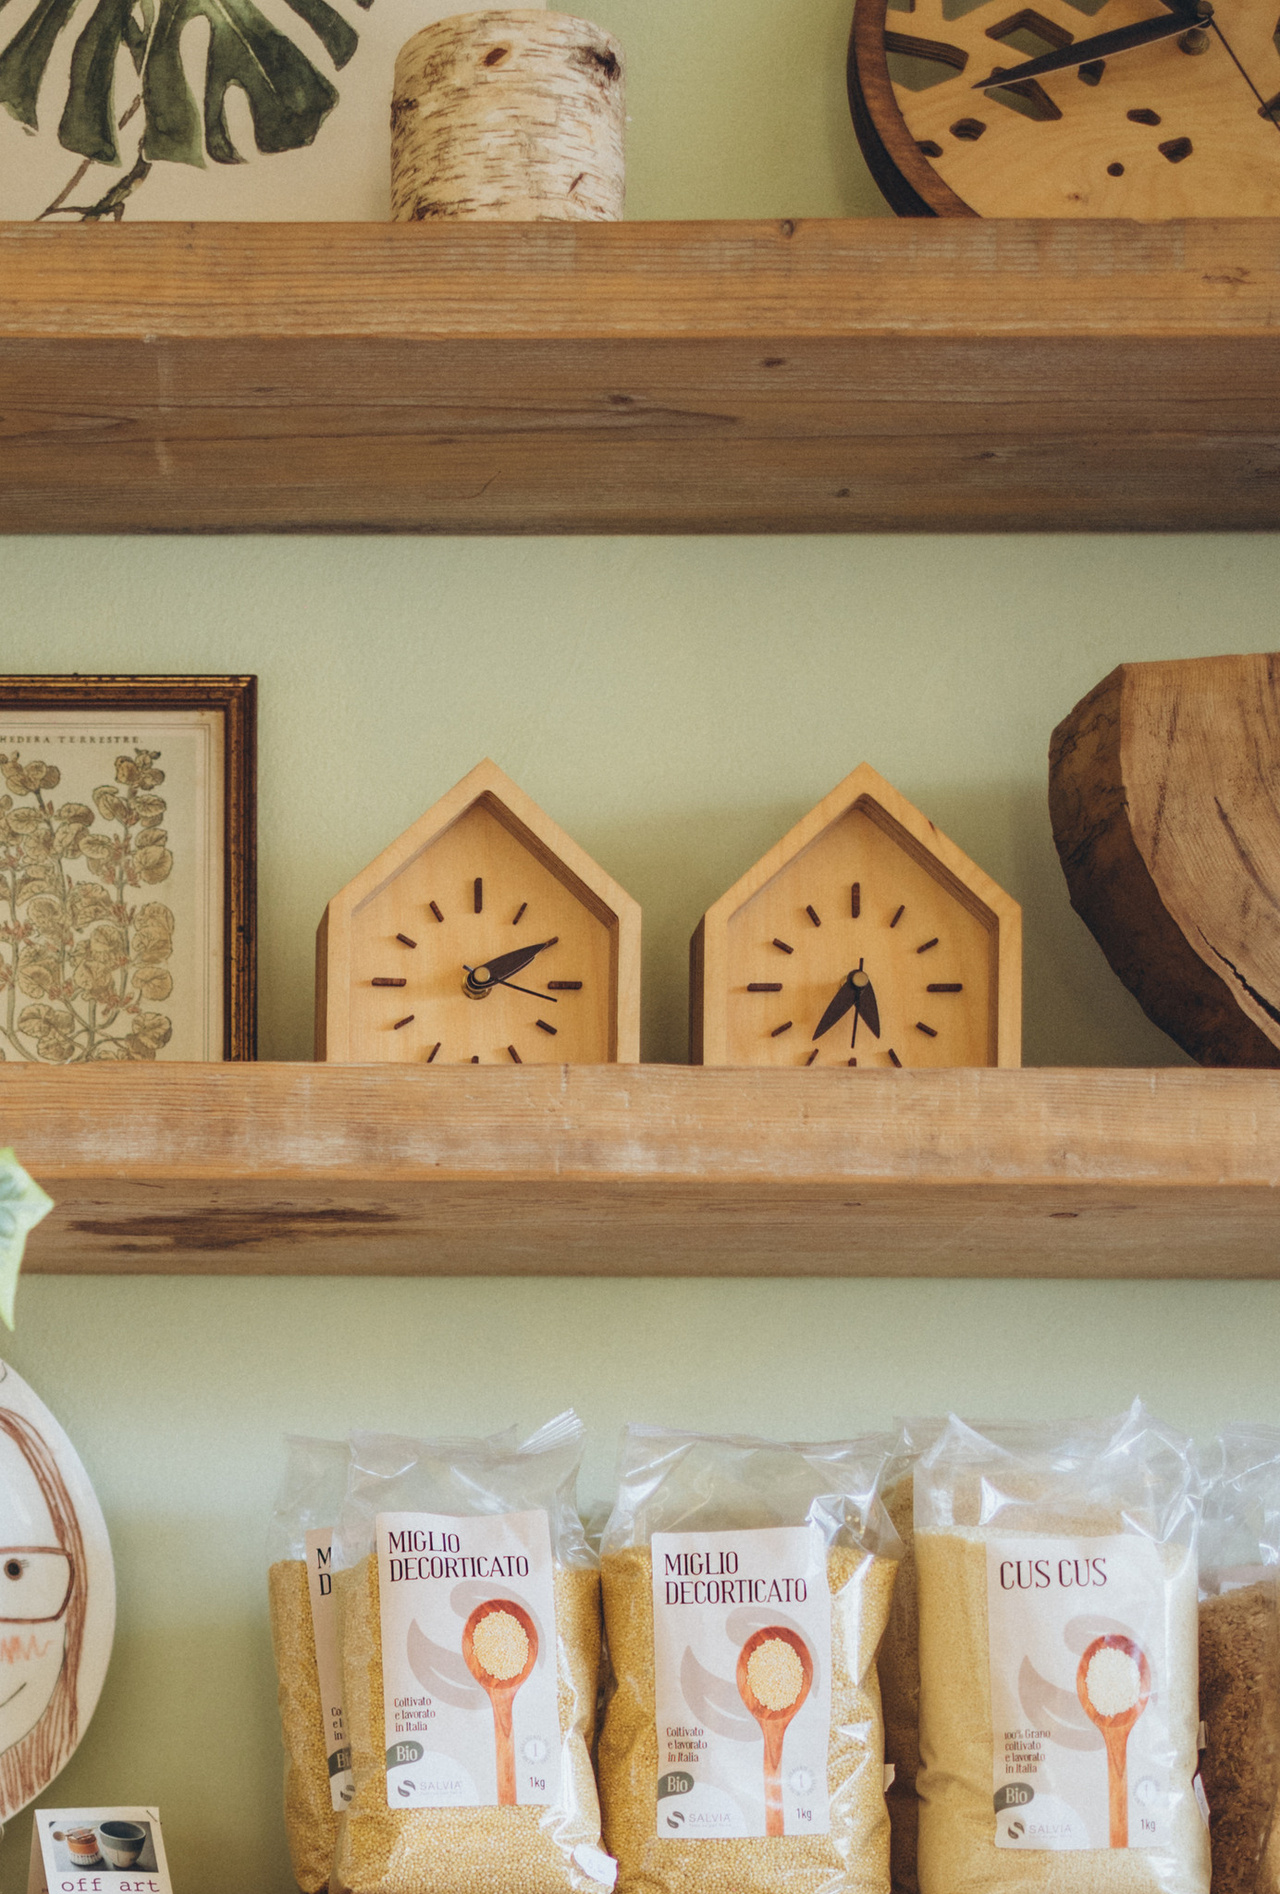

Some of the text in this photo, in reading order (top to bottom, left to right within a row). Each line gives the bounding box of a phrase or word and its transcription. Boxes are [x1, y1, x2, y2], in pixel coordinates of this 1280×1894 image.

[0, 735, 50, 744] HEDERA
[388, 1530, 461, 1554] MIGLIO
[390, 1555, 529, 1582] DECORTICATO
[664, 1551, 739, 1576] MIGLIO
[1000, 1557, 1107, 1590] CUS CUS
[665, 1578, 807, 1605] DECORTICATO
[394, 1697, 432, 1708] Coltivato
[394, 1709, 436, 1720] e lavorato
[395, 1721, 428, 1732] in Italia
[666, 1726, 704, 1738] Coltivato
[1024, 1729, 1051, 1739] Grano
[667, 1739, 708, 1750] e lavorato
[1004, 1741, 1041, 1751] coltivato
[396, 1746, 418, 1762] Bio
[667, 1752, 699, 1762] in Italia
[1005, 1752, 1046, 1762] e lavorato
[1005, 1763, 1037, 1774] in Italia
[420, 1780, 461, 1791] SALVIA
[529, 1776, 546, 1790] 1kg
[667, 1776, 688, 1793] Bio
[1005, 1787, 1028, 1804] Bio
[689, 1813, 731, 1823] SALVIA
[796, 1808, 812, 1822] 1kg
[1140, 1819, 1156, 1832] 1kg
[61, 1877, 102, 1893] off
[119, 1879, 160, 1893] art
